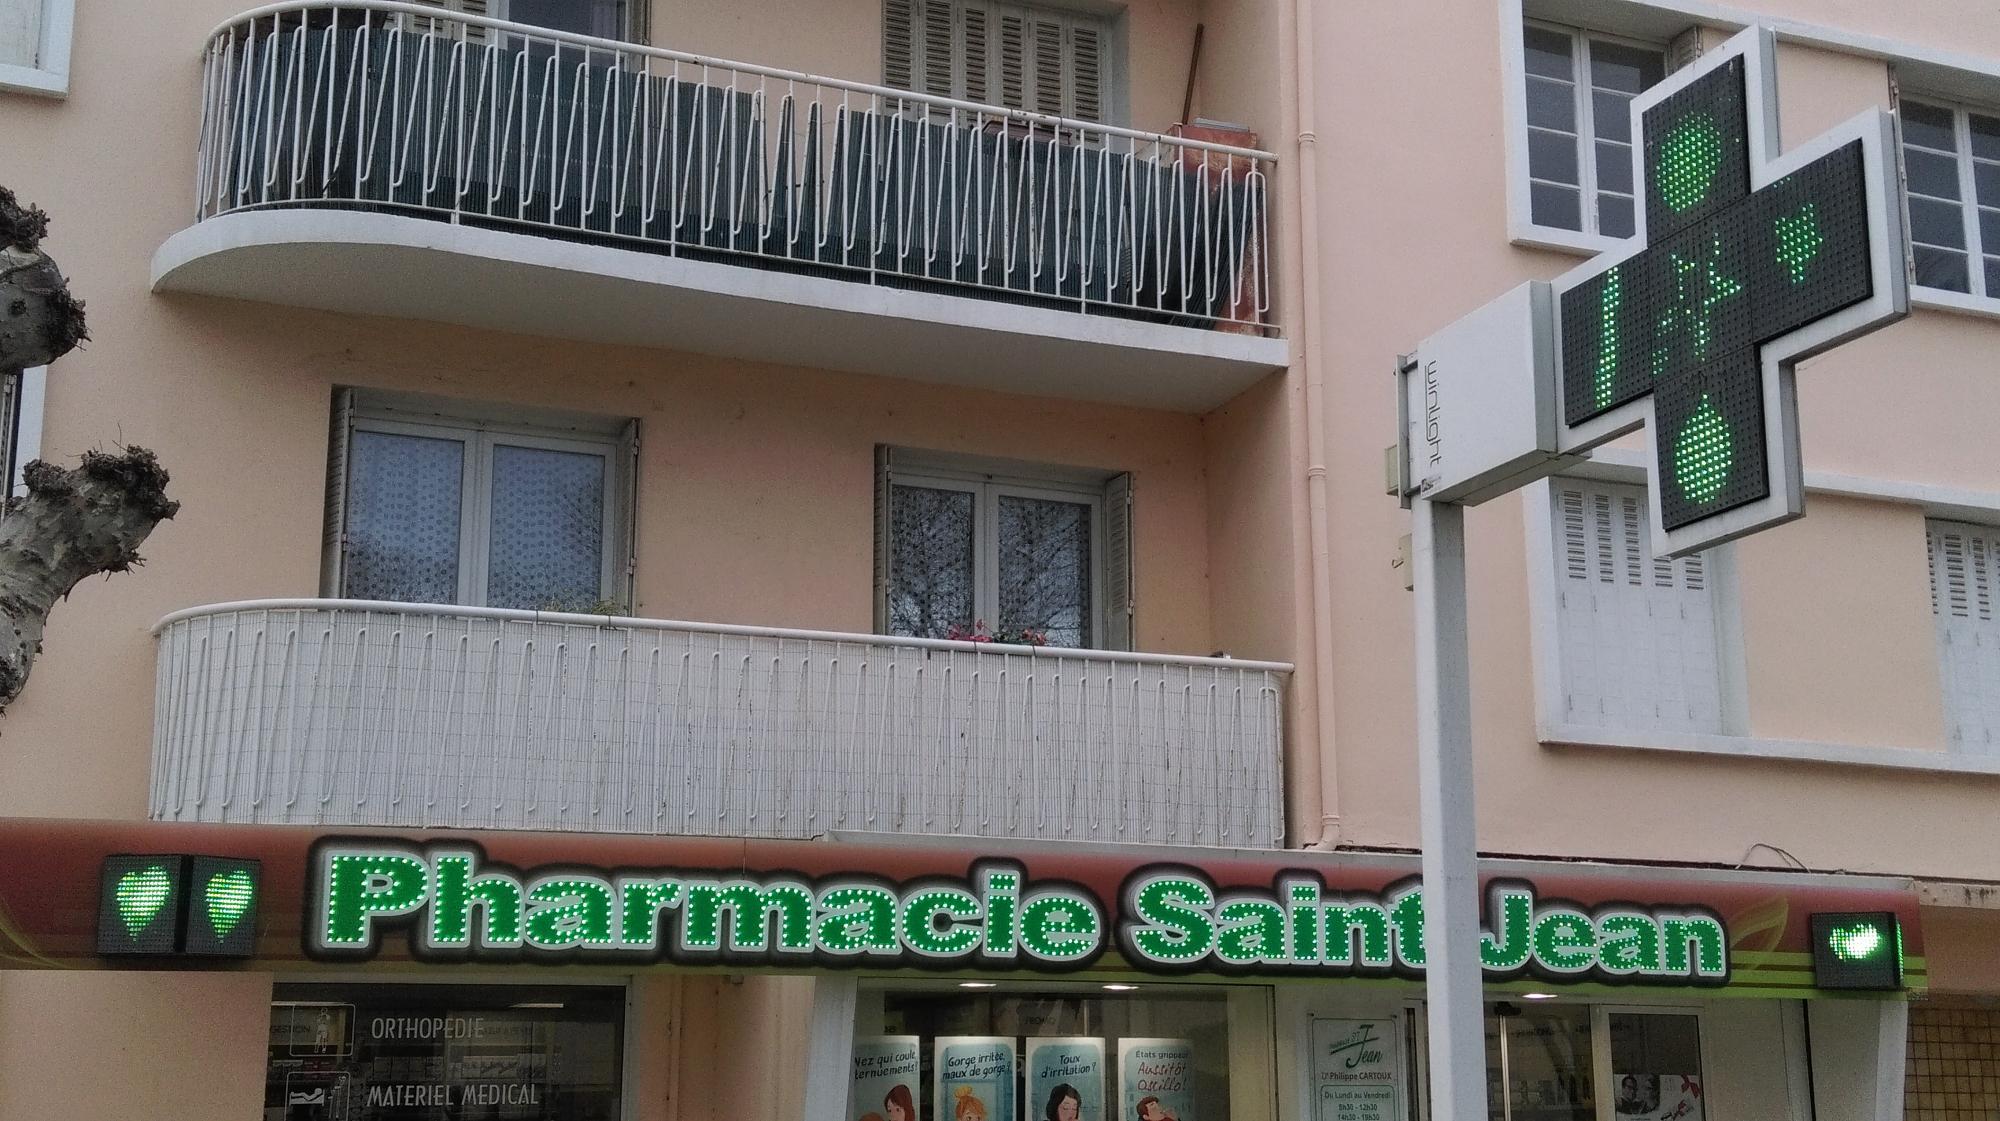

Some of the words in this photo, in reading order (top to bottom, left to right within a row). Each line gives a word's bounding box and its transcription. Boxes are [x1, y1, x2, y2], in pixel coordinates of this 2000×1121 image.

[1424, 360, 1442, 468] winlight
[322, 851, 1101, 960] Pharmacie
[1132, 875, 1427, 969] Saint
[1481, 889, 1728, 977] Jean
[371, 1017, 485, 1039] ORTHOPEDIE
[1346, 1024, 1384, 1069] Jean
[877, 1053, 894, 1069] qui
[948, 1056, 976, 1069] Gorge
[1059, 1054, 1081, 1065] Toux
[942, 1069, 968, 1081] maux
[970, 1064, 982, 1077] de
[1137, 1061, 1187, 1076] Aussitôt
[1329, 1072, 1358, 1081] Philippe
[366, 1085, 454, 1107] MATERIEL
[461, 1083, 539, 1105] MEDICAL
[1324, 1091, 1334, 1099] Du
[1335, 1091, 1353, 1099] Lundi
[1359, 1103, 1378, 1111] 12h30
